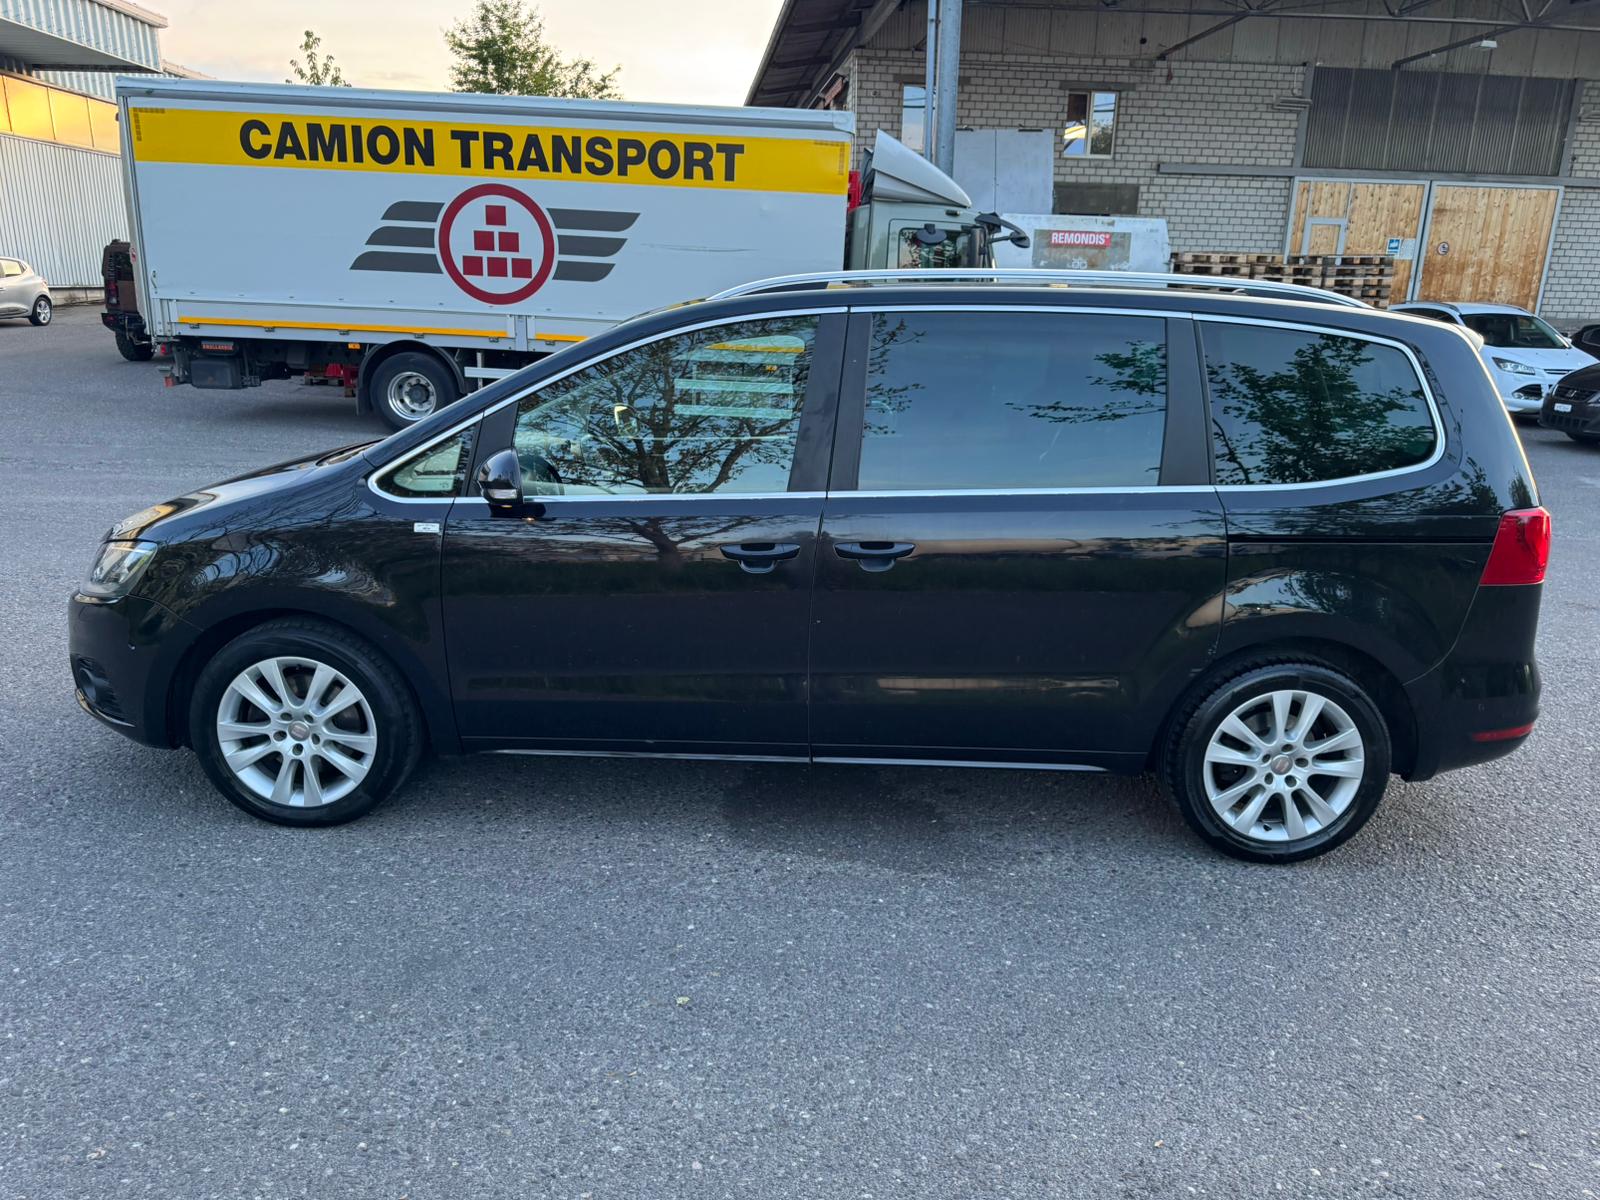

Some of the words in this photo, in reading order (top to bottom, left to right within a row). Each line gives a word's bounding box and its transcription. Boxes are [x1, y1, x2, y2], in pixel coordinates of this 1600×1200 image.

[240, 119, 435, 167] CAMION
[450, 130, 745, 182] TRANSPORT
[1051, 232, 1106, 245] REMONDIS
